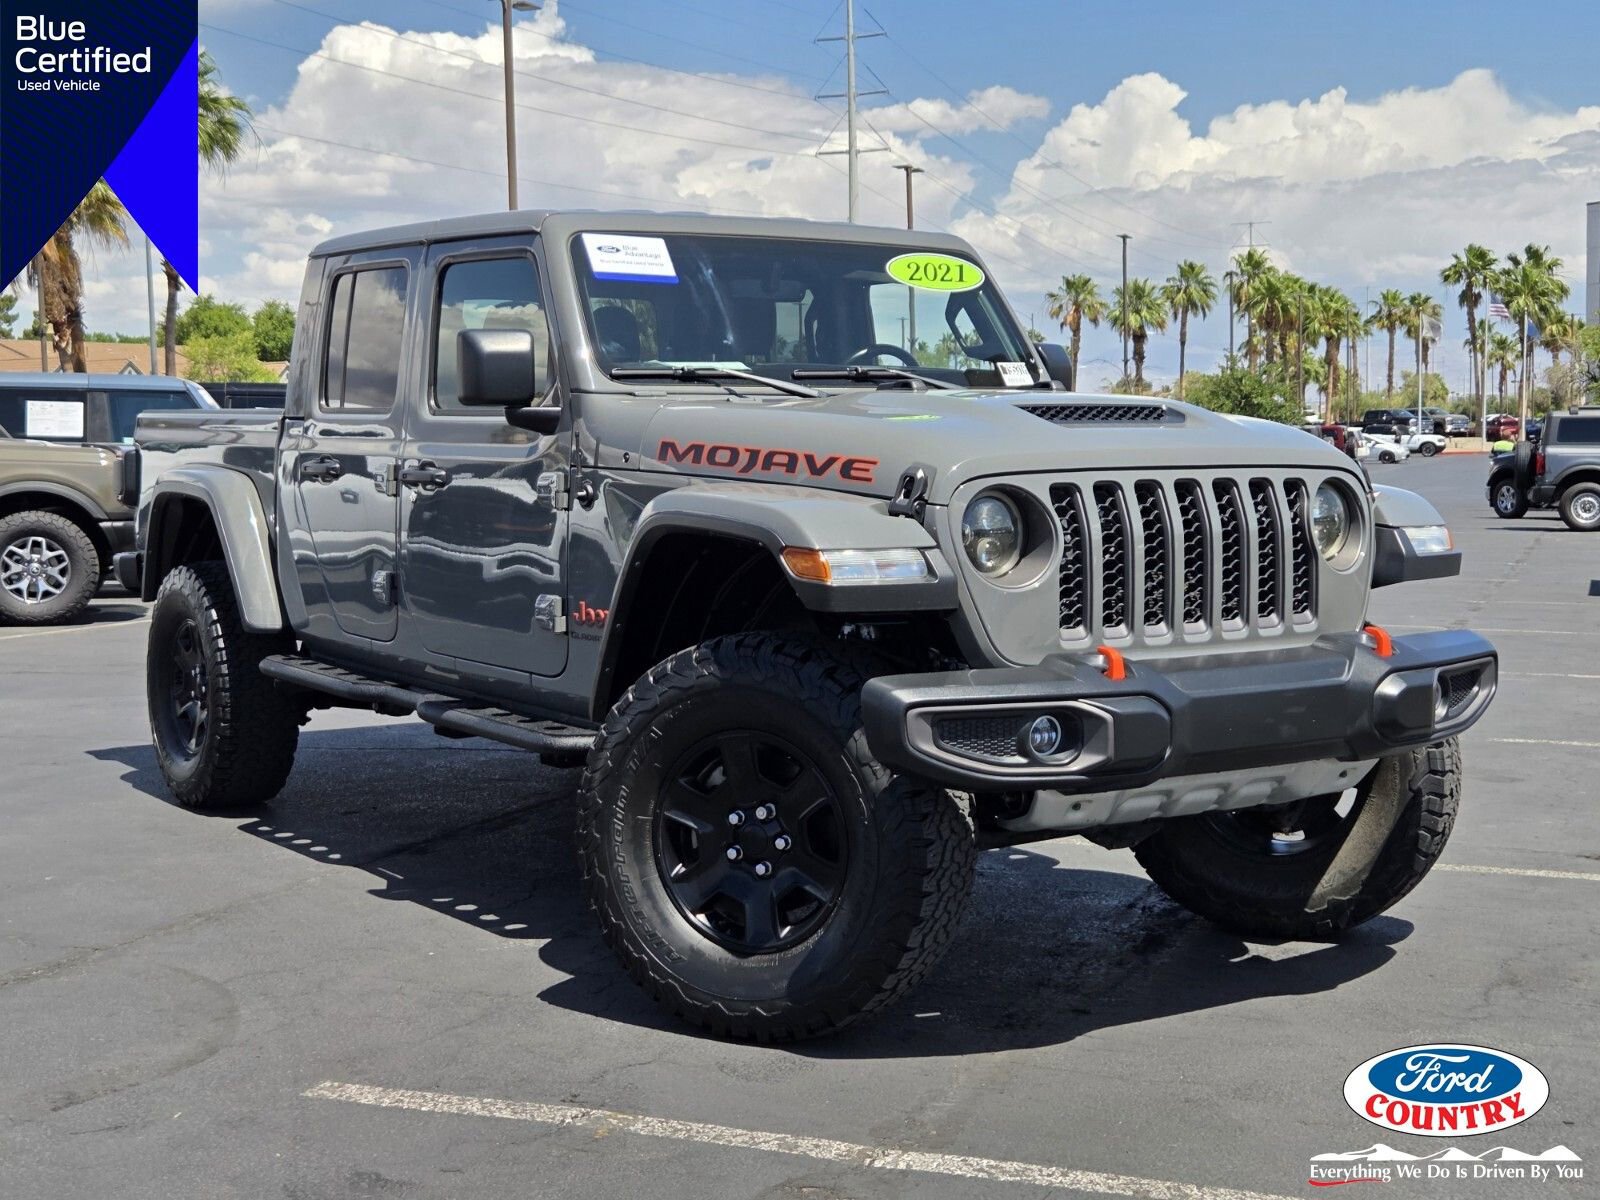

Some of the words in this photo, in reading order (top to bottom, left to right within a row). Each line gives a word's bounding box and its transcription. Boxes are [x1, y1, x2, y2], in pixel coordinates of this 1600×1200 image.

[907, 261, 967, 283] 2021
[656, 436, 880, 483] MOJAVE
[572, 600, 609, 627] Jee
